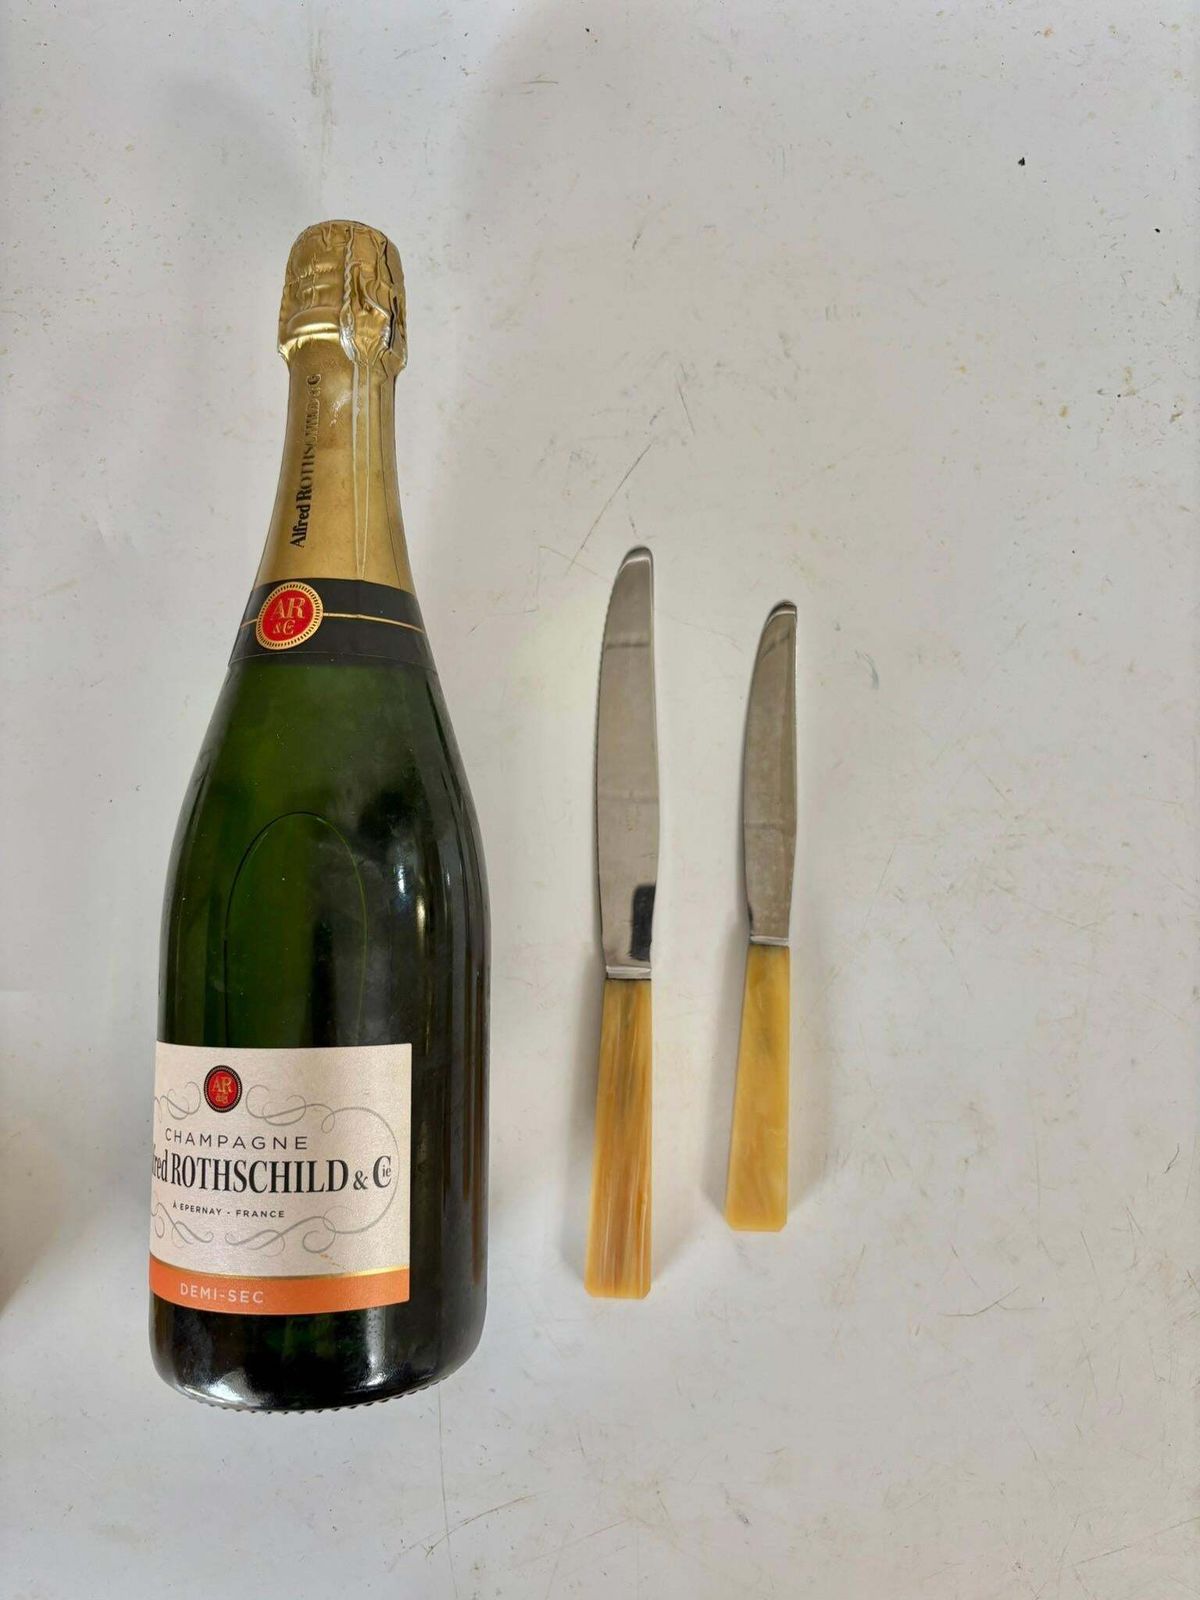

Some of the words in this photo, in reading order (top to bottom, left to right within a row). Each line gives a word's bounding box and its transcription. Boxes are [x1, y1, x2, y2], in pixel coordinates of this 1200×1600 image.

[290, 504, 311, 548] Alfred
[271, 597, 306, 620] AR
[165, 1127, 309, 1151] CHAMPAGNE
[170, 1152, 349, 1194] ROTHSCHILD
[352, 1170, 369, 1190] &
[179, 1202, 222, 1216] EPERNAY
[235, 1209, 285, 1218] FRANCE
[180, 1282, 264, 1304] DEMI-SEC
